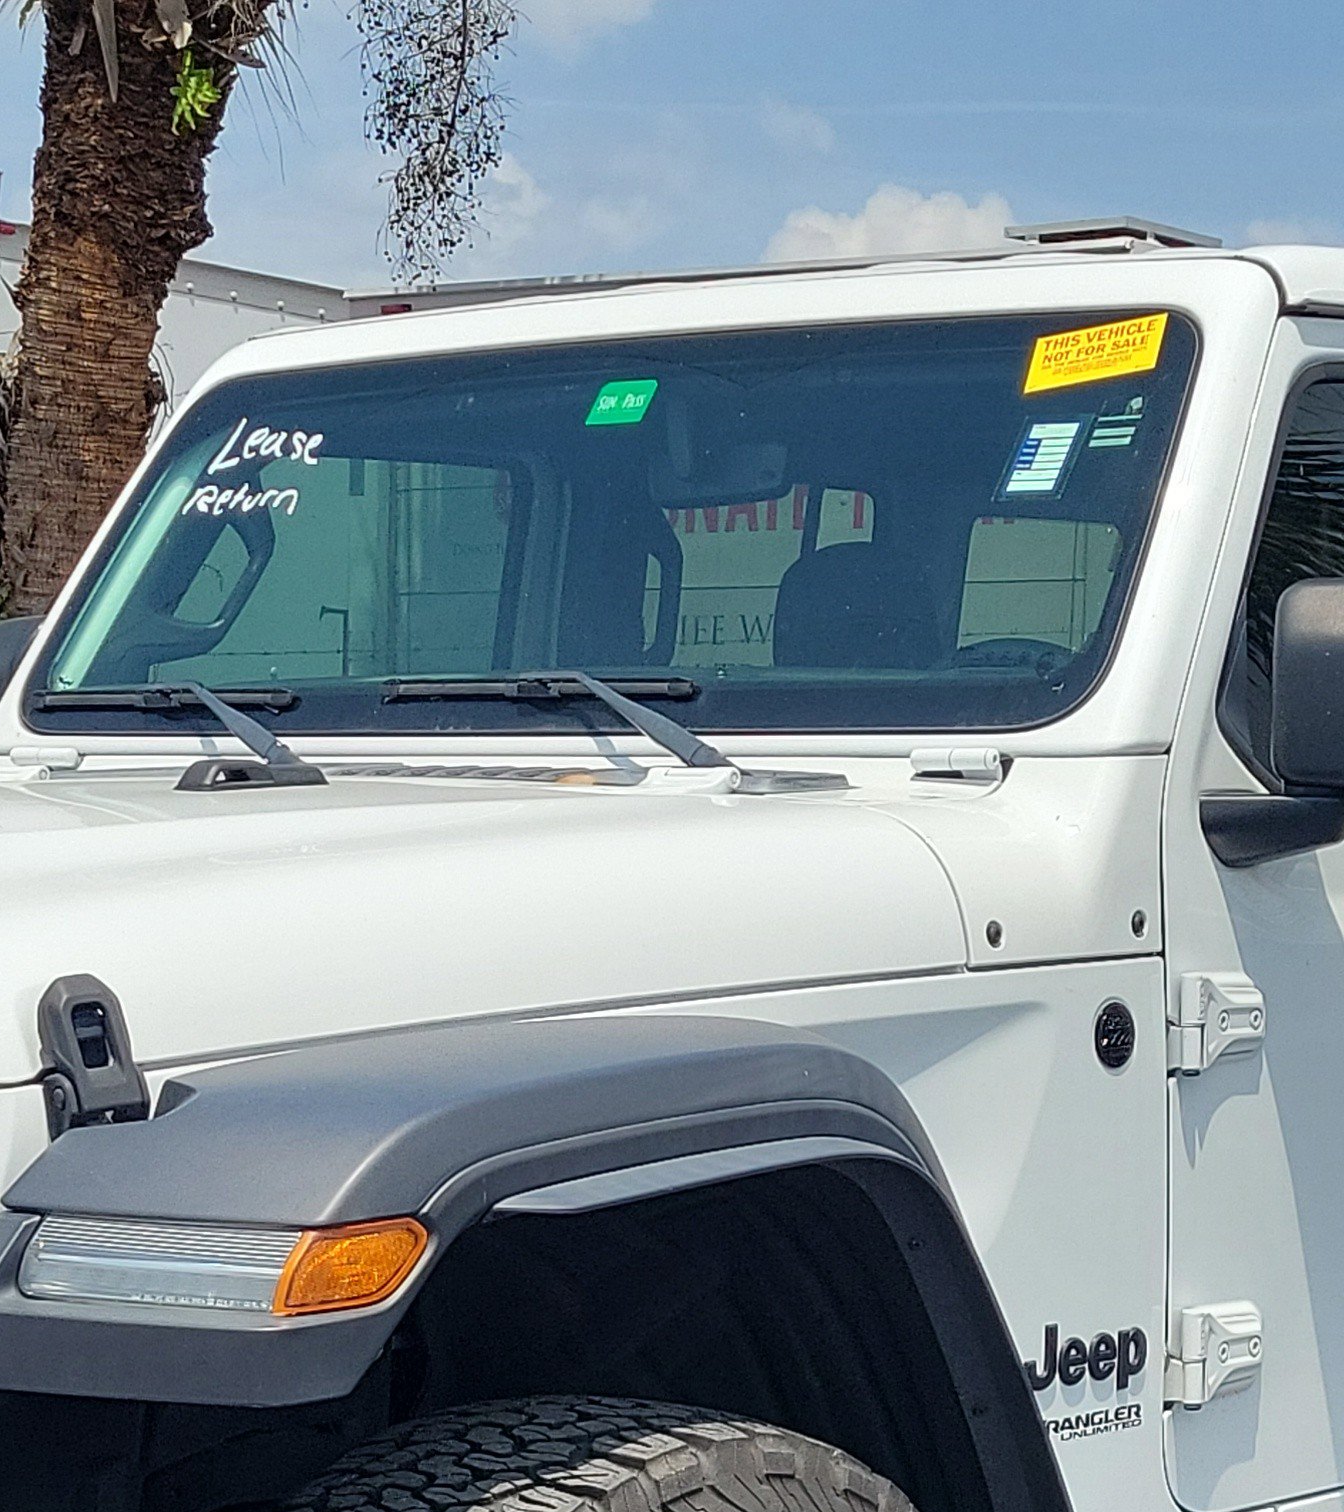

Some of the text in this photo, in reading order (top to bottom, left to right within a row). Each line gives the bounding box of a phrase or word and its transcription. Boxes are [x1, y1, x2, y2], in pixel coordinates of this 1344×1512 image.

[1043, 319, 1159, 352] THIS VEHICLE
[1042, 351, 1070, 364] NOT
[1076, 344, 1106, 357] FOR
[207, 417, 324, 475] Lease
[1023, 1323, 1147, 1391] Jeep
[1042, 1403, 1142, 1434] RANGLER
[1060, 1419, 1142, 1441] UNLIMITED
